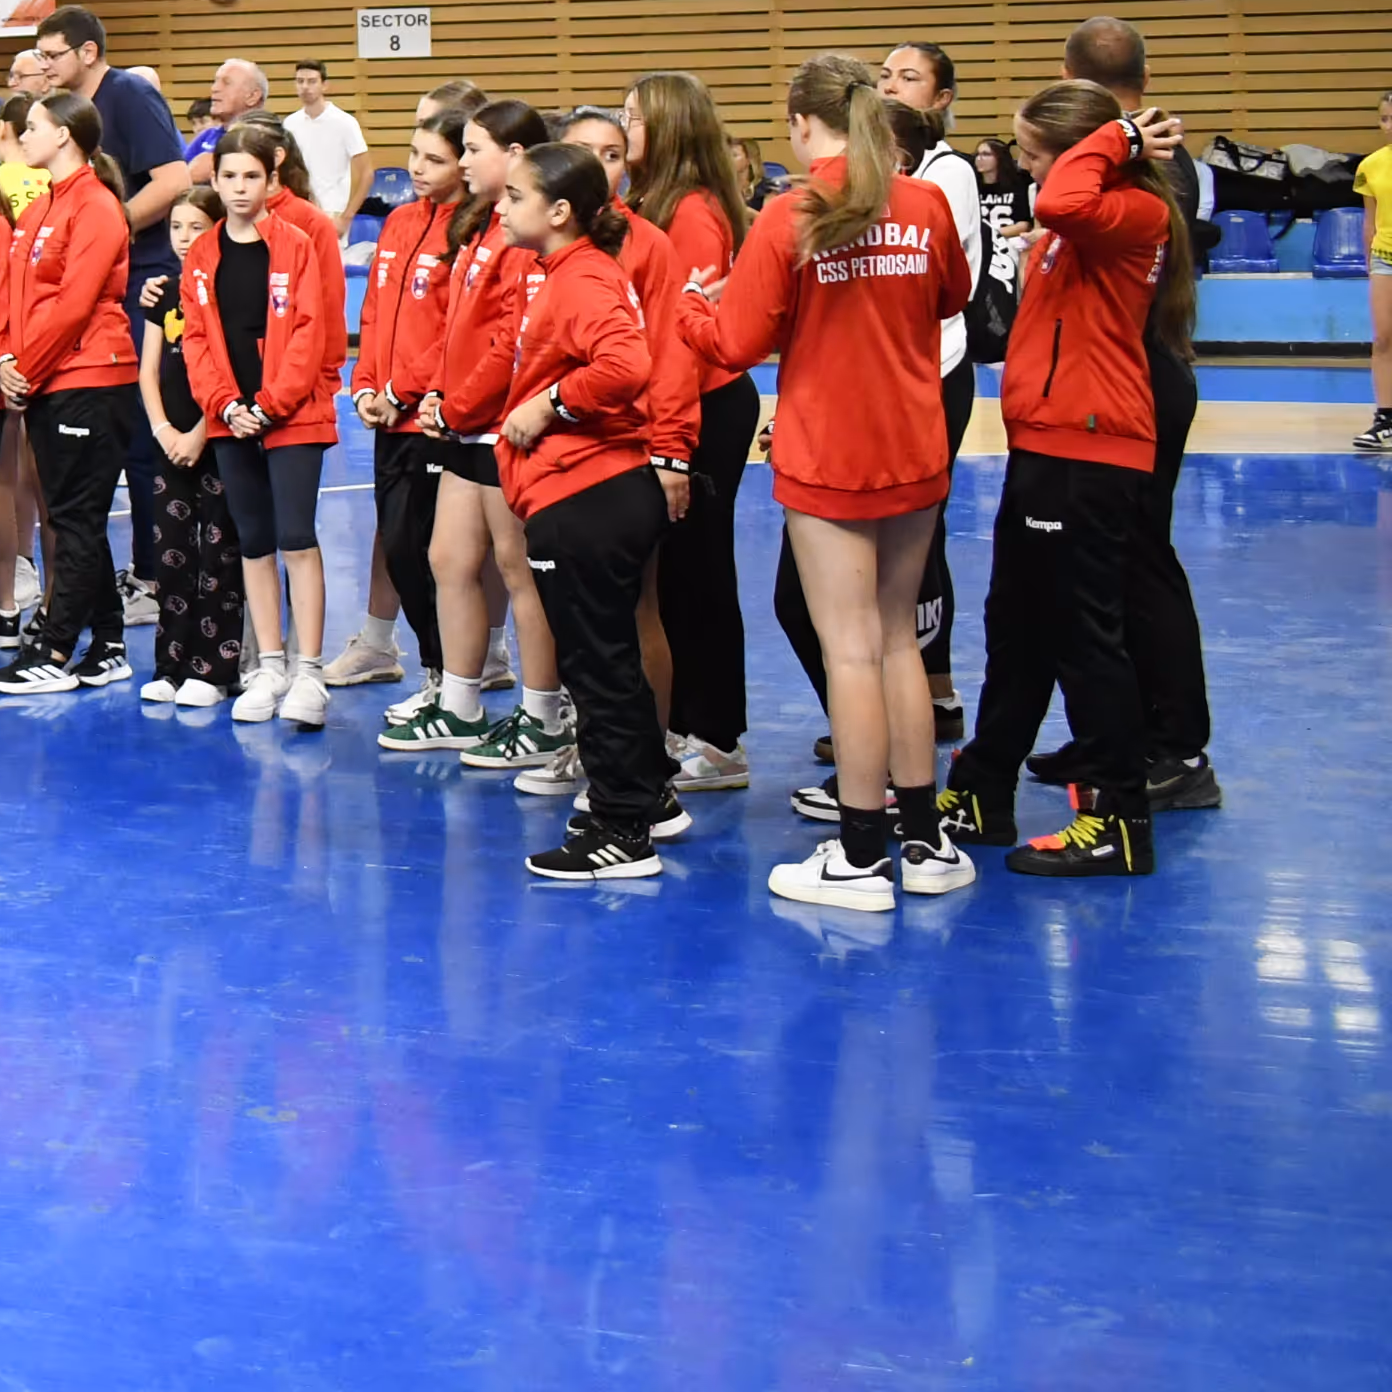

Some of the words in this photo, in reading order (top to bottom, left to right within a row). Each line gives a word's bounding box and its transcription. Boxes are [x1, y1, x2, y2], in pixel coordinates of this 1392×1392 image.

[361, 14, 429, 28] SECTOR
[390, 35, 401, 51] 8
[816, 261, 849, 284] CSS
[1026, 516, 1063, 533] Kempa
